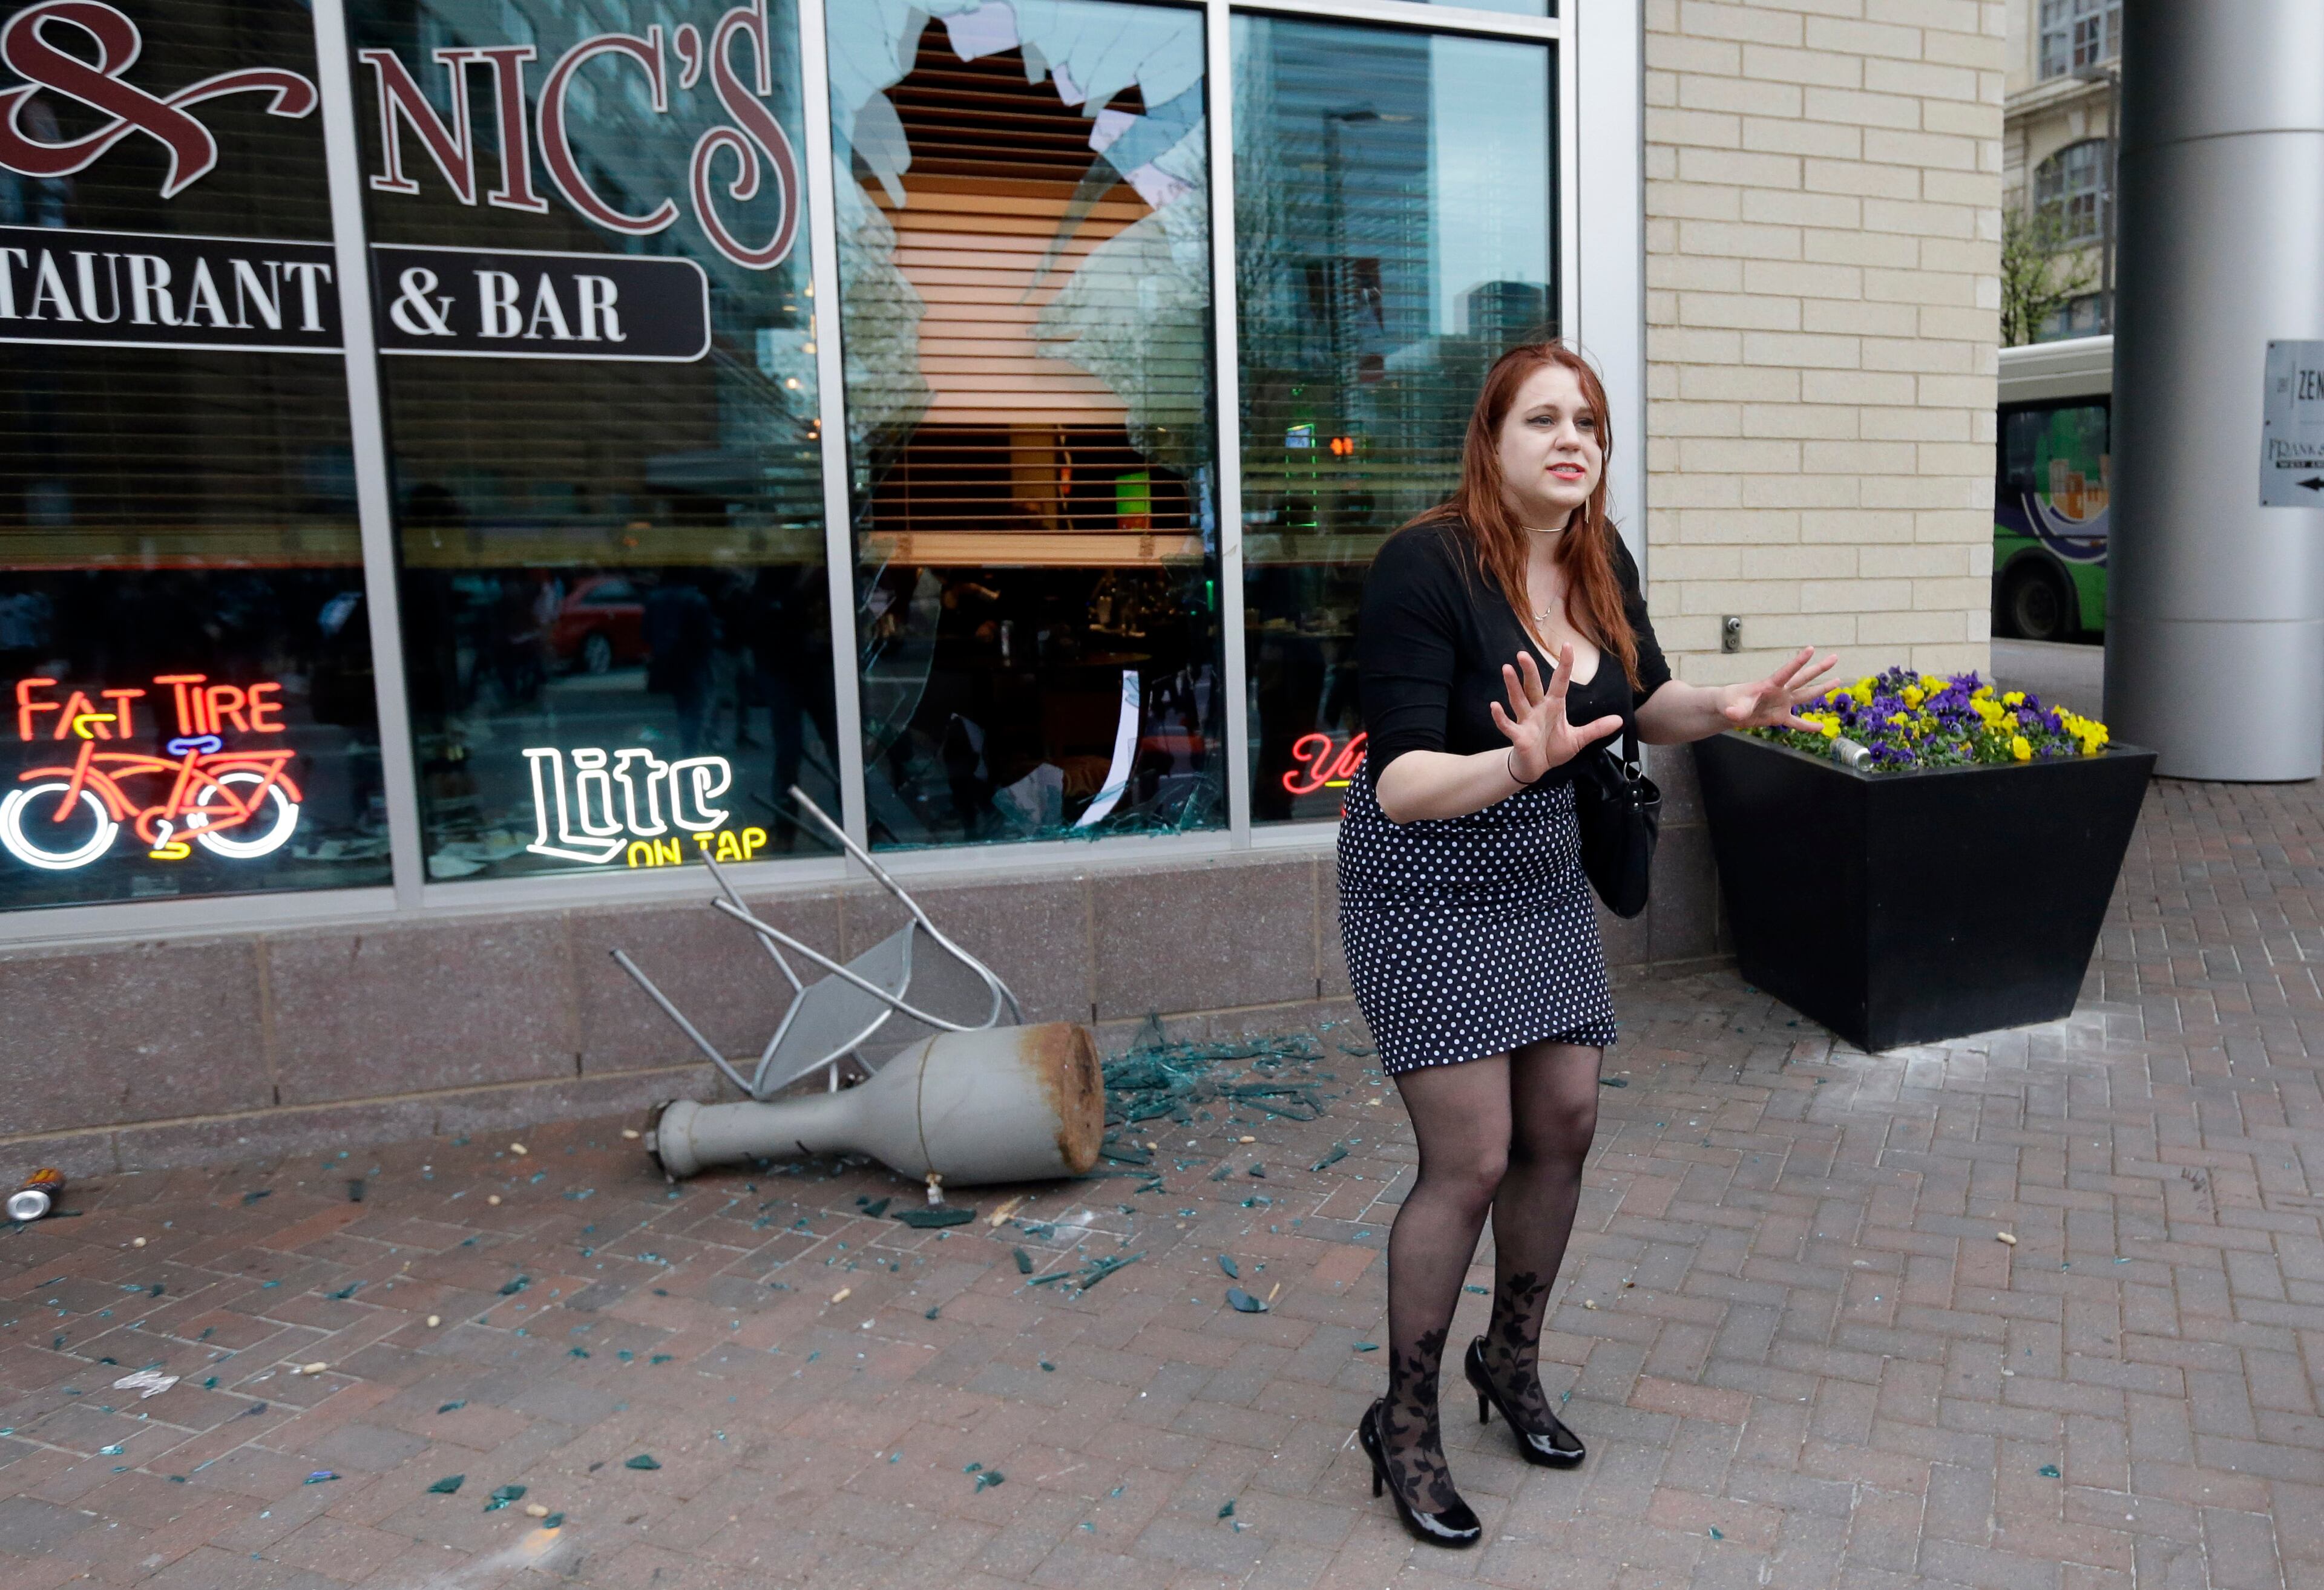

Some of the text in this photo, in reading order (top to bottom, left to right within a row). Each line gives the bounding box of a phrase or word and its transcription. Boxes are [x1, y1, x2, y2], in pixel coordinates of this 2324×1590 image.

[0, 0, 799, 270] & NIC'S
[389, 267, 458, 336] &
[473, 270, 628, 343] BAR
[16, 673, 286, 741] FAT TIRE
[521, 747, 732, 864] Lite
[626, 826, 767, 869] ON TAP
